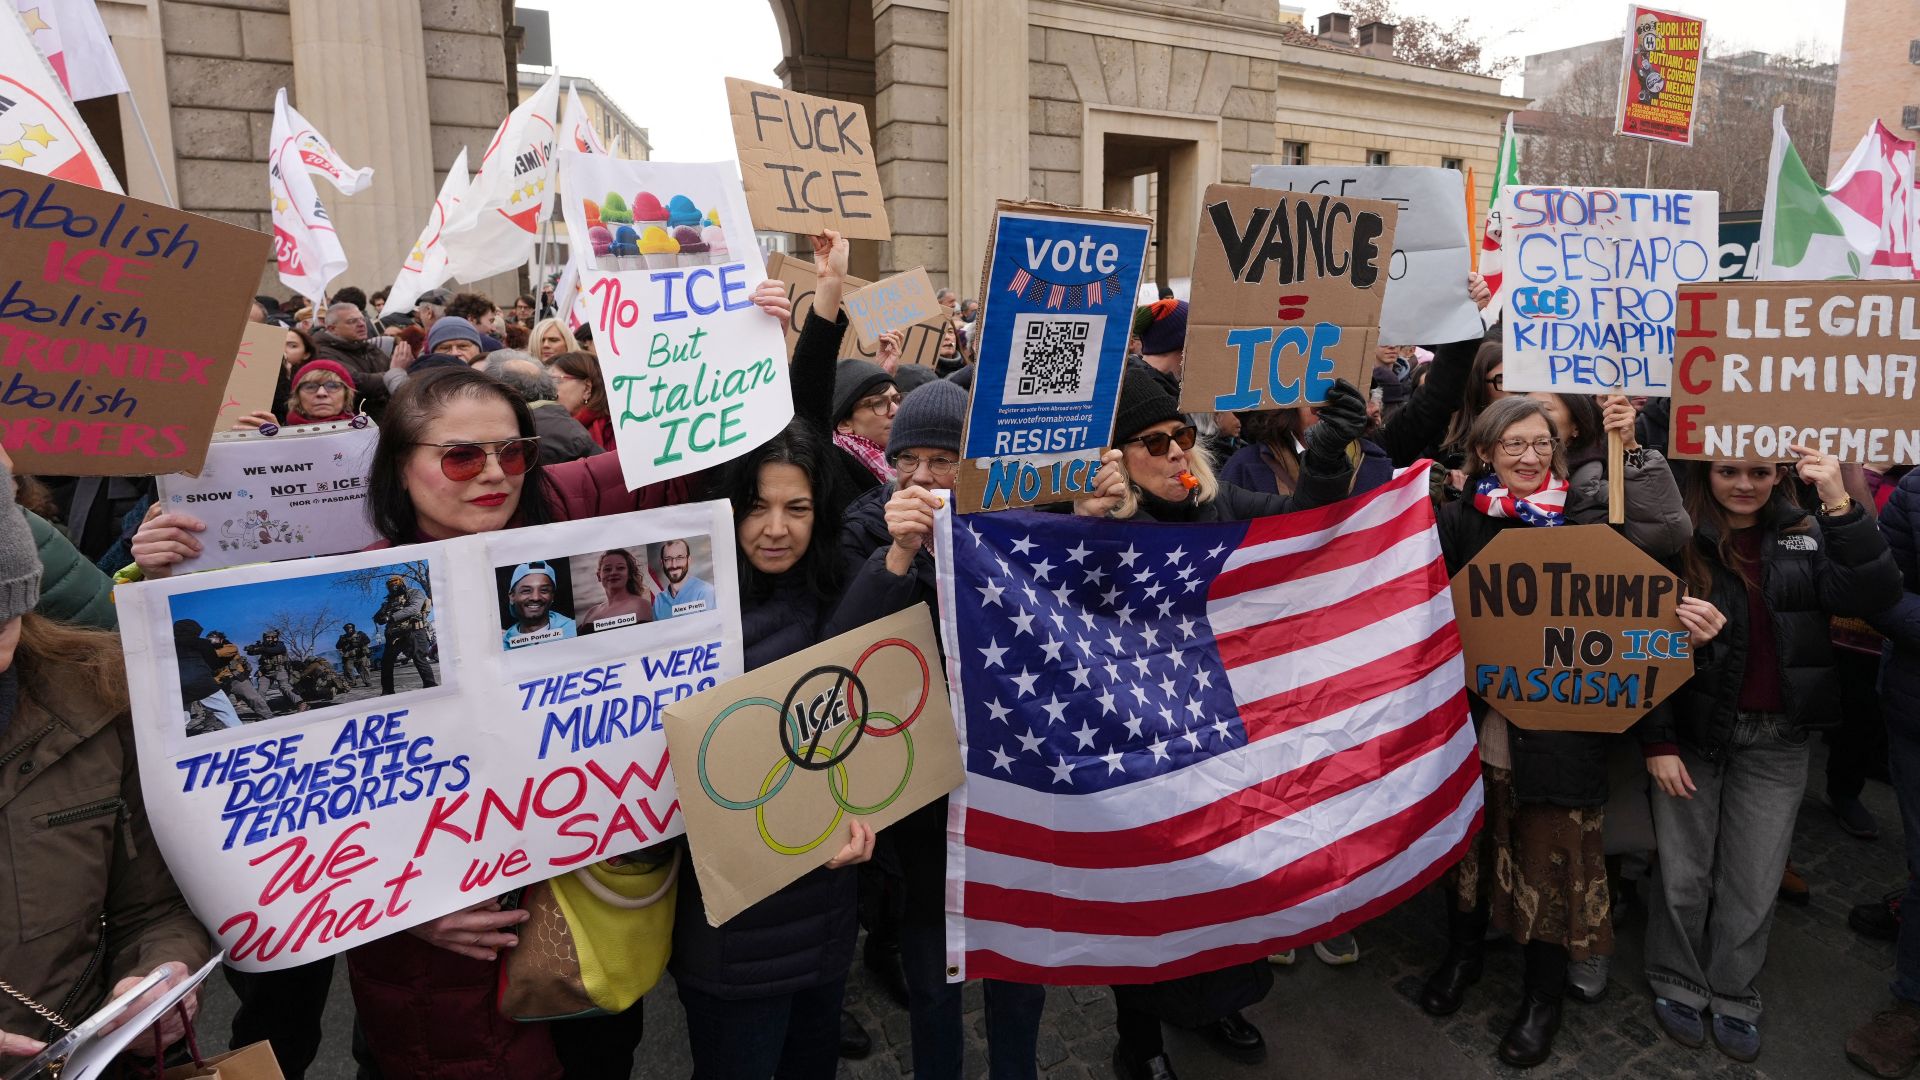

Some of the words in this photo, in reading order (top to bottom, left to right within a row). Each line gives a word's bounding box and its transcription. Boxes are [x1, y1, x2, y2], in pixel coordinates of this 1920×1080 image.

[1656, 22, 1679, 35] FUORI
[1681, 22, 1699, 35] L'ICE
[1656, 37, 1666, 50] DA
[1669, 37, 1699, 50] MILANO
[1649, 51, 1683, 68] BUTTIAMO
[1667, 69, 1695, 84] GOVERNO
[1659, 92, 1692, 104] MUSSOLINI
[1660, 100, 1692, 112] GONNELLA
[1666, 81, 1694, 96] MELONI
[750, 91, 863, 155] FUCK
[307, 154, 338, 175] 2050
[764, 163, 872, 218] ICE
[1511, 188, 1618, 229] STOP
[1620, 193, 1694, 225] THE
[0, 183, 200, 270] abolish
[1206, 195, 1384, 290] VANCE
[42, 241, 156, 297] ICE
[1025, 235, 1119, 274] vote
[1518, 232, 1709, 284] GESTAPO
[0, 280, 148, 338] bolish
[650, 263, 755, 322] ICE
[1590, 286, 1677, 322] FRO
[1676, 291, 1920, 341] ILLEGAL
[647, 326, 708, 369] But
[1214, 322, 1343, 412] ICE
[1549, 354, 1674, 388] PEOPL
[0, 372, 138, 418] bolish
[612, 357, 777, 431] Italian
[1678, 346, 1917, 400] CRIMINA
[0, 415, 188, 460] RDERS
[653, 402, 747, 467] ICE
[995, 427, 1088, 455] RESIST!
[997, 413, 1093, 426] www.votefromabroad.org
[1675, 404, 1920, 464] ENFORCEMEN
[186, 491, 232, 503] SNOW
[270, 483, 307, 496] NOT
[332, 477, 361, 489] ICE
[243, 466, 267, 476] WE
[270, 462, 314, 474] WANT
[981, 459, 1041, 511] NO
[1051, 458, 1102, 495] ICE
[322, 492, 368, 503] PASDARAN
[1468, 562, 1538, 618] NO
[511, 637, 529, 646] Keith
[530, 633, 551, 642] Porter
[617, 616, 635, 625] Good
[1543, 626, 1614, 668] NO
[1621, 629, 1690, 660] ICE
[518, 663, 626, 711] THESE
[640, 641, 722, 682] WERE
[794, 686, 849, 744] ICE
[176, 734, 304, 792] THESE
[330, 709, 409, 755] ARE
[224, 736, 434, 812] DOMESTIC
[221, 755, 471, 850] TERRORISTS
[413, 747, 670, 858] KNOW
[218, 861, 422, 962] What
